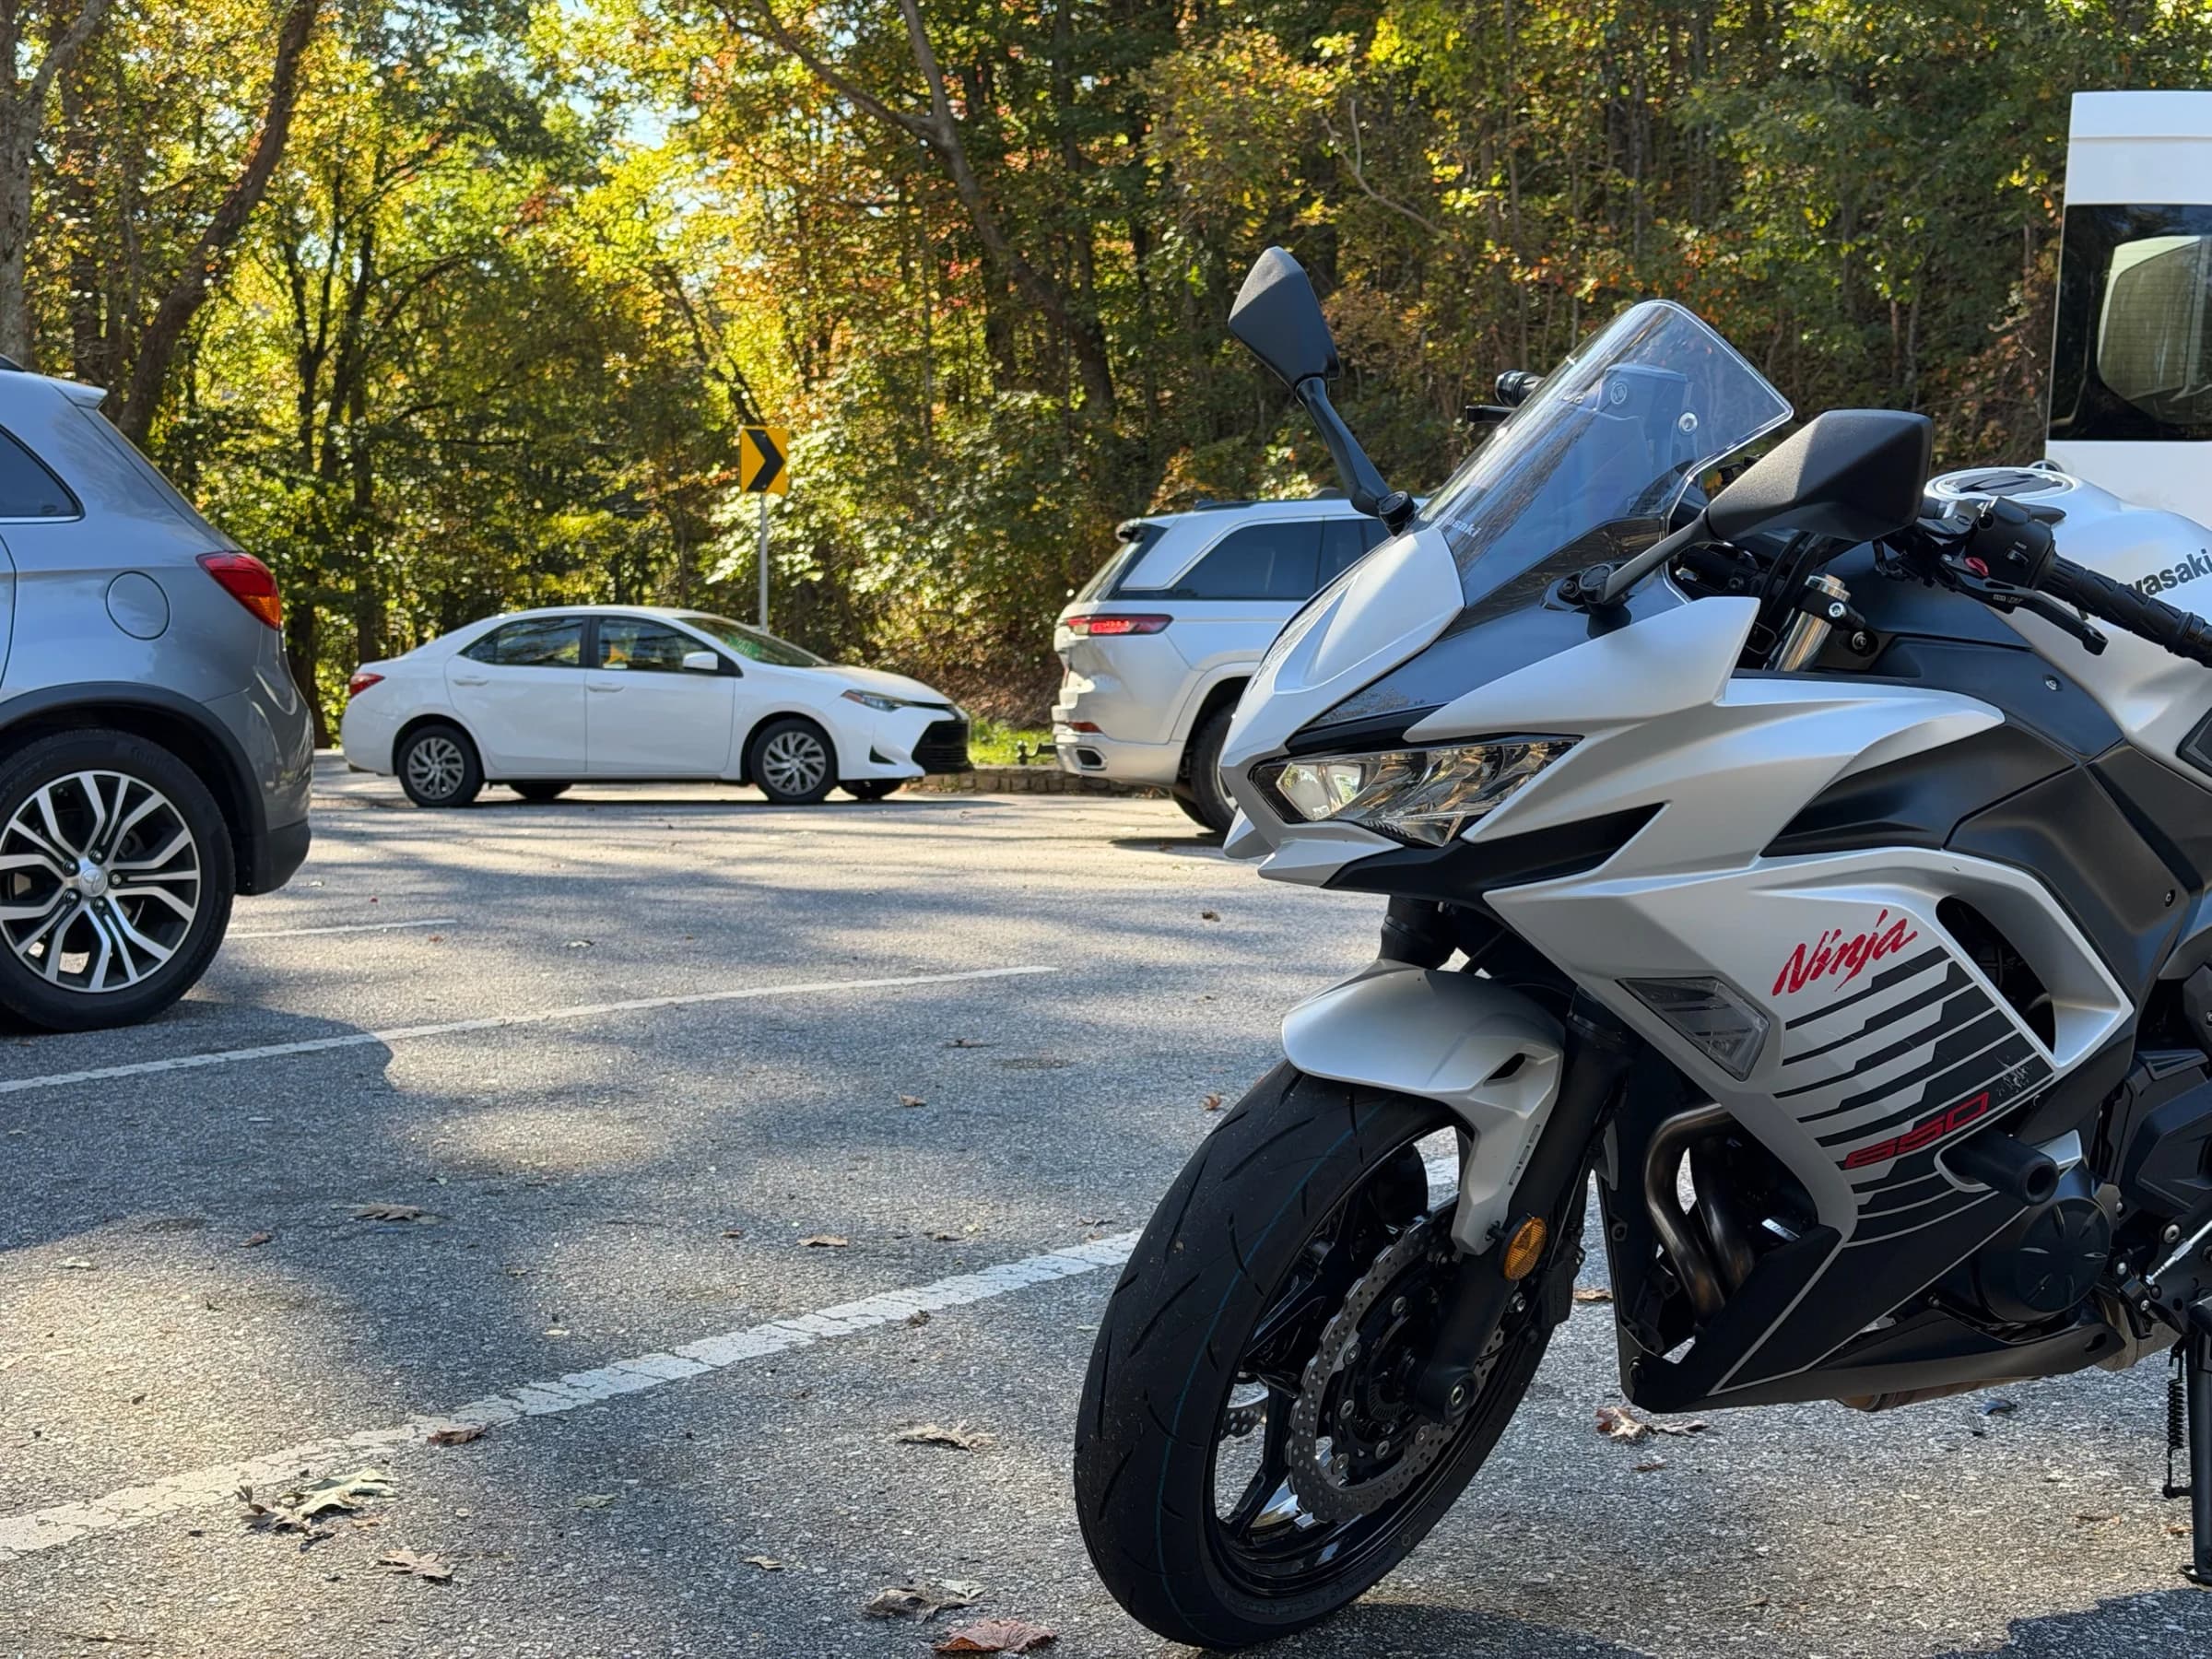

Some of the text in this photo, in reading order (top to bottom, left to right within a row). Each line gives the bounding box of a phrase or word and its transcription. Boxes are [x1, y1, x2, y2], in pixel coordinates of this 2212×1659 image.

[2135, 547, 2212, 596] asaki
[1771, 909, 1918, 996] Ninja
[1845, 1091, 1989, 1169] 650
